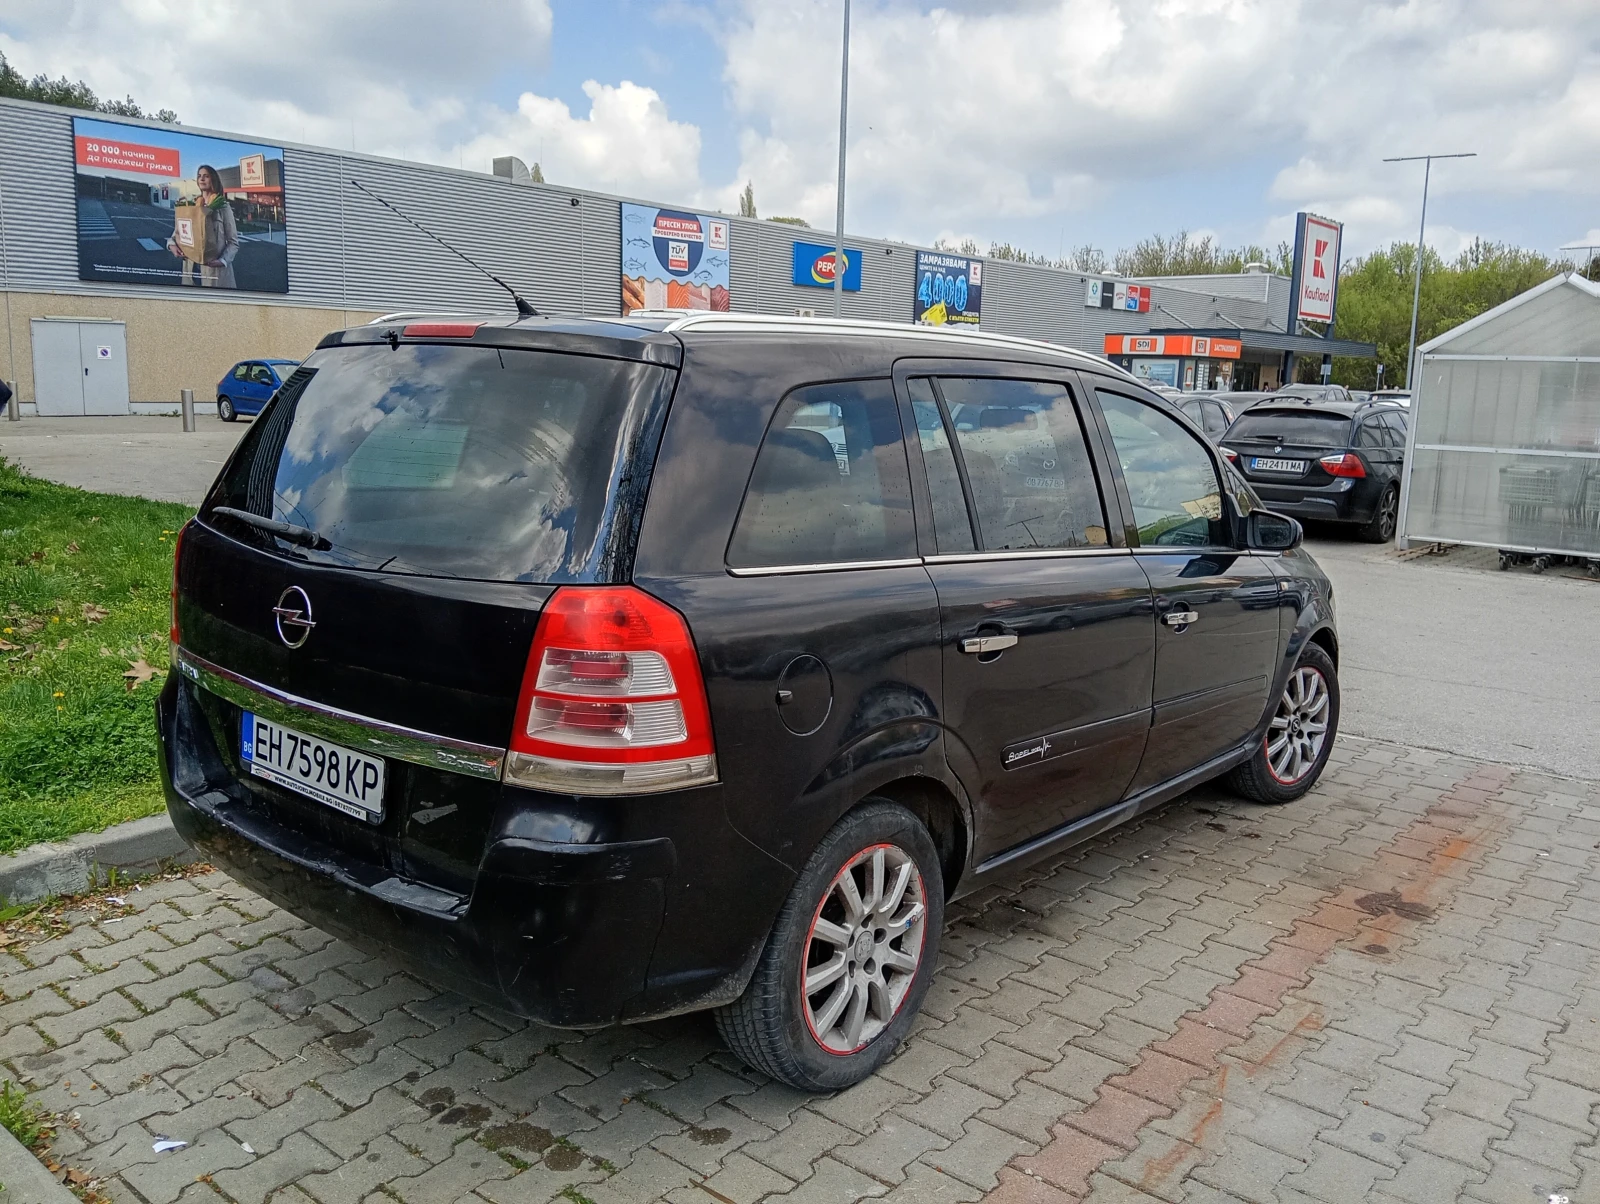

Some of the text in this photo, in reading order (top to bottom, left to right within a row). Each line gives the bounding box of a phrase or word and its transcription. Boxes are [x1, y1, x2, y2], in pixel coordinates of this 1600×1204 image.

[86, 143, 155, 160] 20 000 начина
[87, 154, 173, 171] да покажеш грижа
[658, 220, 681, 229] ПРЕСЕН
[654, 229, 680, 237] ПРОВЕРЕНО
[671, 245, 686, 254] TÜV
[919, 253, 967, 269] ЗАМРАЗЯВАМЕ
[918, 271, 968, 312] 4000
[1304, 285, 1330, 303] Kaufland
[1137, 340, 1150, 348] SDI
[243, 740, 252, 754] BG
